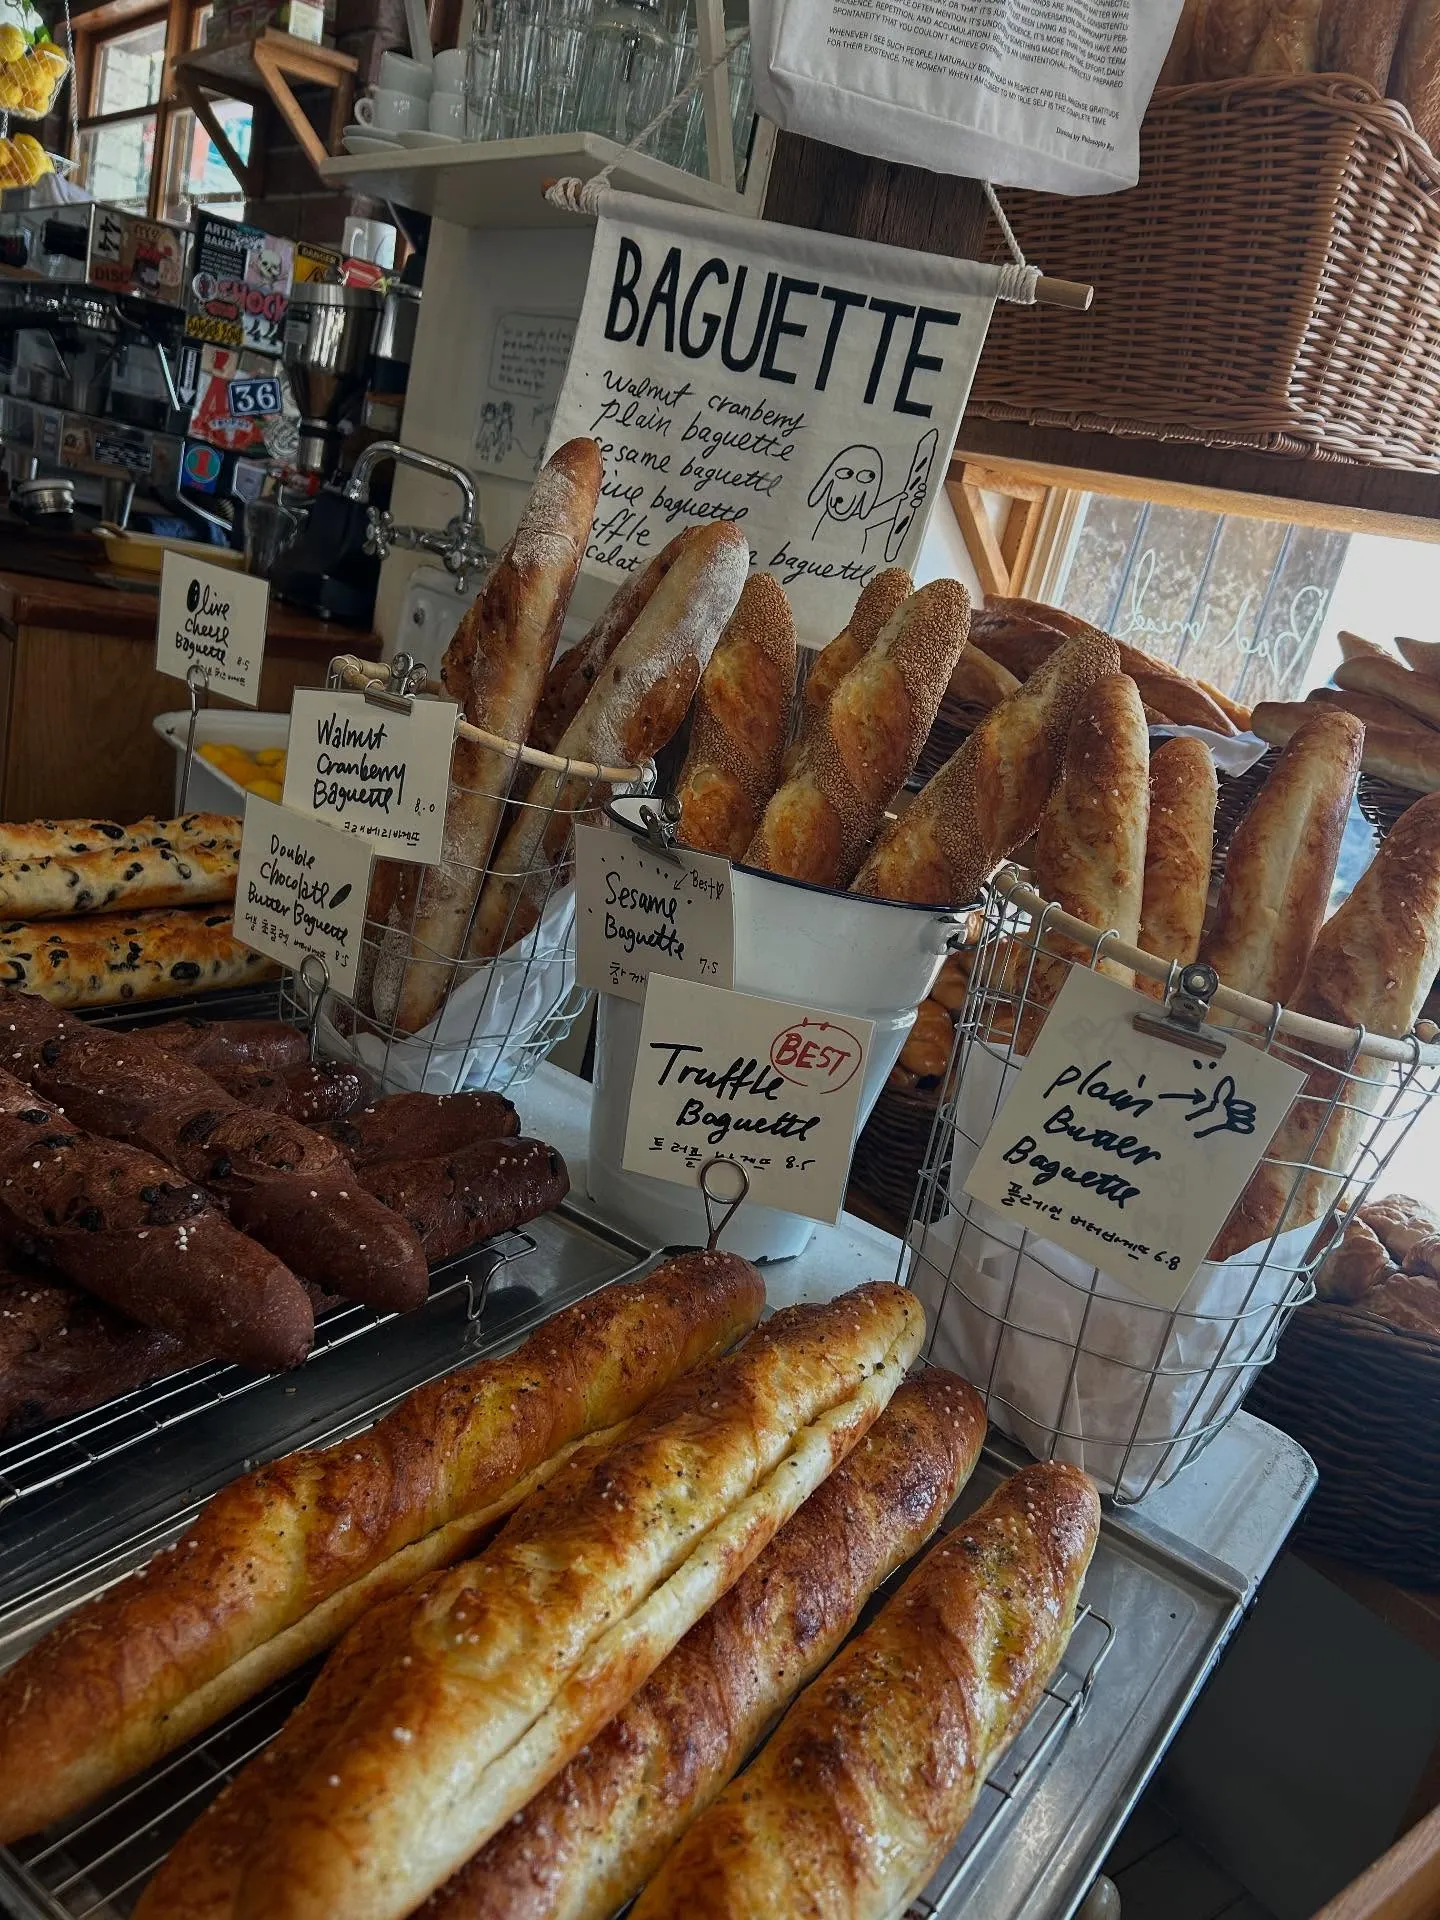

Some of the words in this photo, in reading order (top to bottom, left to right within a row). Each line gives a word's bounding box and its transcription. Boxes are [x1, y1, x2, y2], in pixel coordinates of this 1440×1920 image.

[833, 6, 881, 20] SPONTANEITY
[882, 15, 898, 26] THAT
[899, 22, 912, 32] YOU
[950, 36, 978, 49] ACHIEVE
[912, 2, 934, 14] OFTEN
[1106, 68, 1125, 76] DAILY
[949, 1, 958, 9] OR
[961, 4, 978, 14] THAT
[980, 6, 992, 14] IT'S
[993, 9, 1007, 19] JUST
[1046, 35, 1064, 45] MORE
[1108, 56, 1126, 65] TERM
[1037, 22, 1056, 32] LIVING
[1059, 26, 1067, 34] AS
[829, 26, 868, 39] WHENEVER
[873, 34, 885, 45] SEE
[887, 39, 904, 51] SUCH
[939, 54, 977, 69] NATURALLY
[1014, 81, 1039, 94] RESPECT
[1040, 88, 1053, 97] AND
[1055, 91, 1067, 101] FEEL
[916, 15, 931, 24] AND
[1092, 75, 1123, 88] PREPARED
[827, 37, 840, 47] FOR
[843, 41, 862, 50] THEIR
[902, 56, 914, 66] THE
[916, 60, 946, 74] MOMENT
[948, 67, 968, 80] WHEN
[974, 75, 984, 84] AM
[1033, 98, 1047, 107] SELF
[1055, 103, 1065, 112] THE
[1092, 116, 1106, 125] TIME
[302, 247, 337, 264] DANGER
[604, 236, 961, 419] BAGUETTE
[235, 383, 275, 412] 36
[708, 393, 808, 436] cranberry
[681, 412, 800, 461] baguette
[680, 456, 783, 497] baguette
[651, 485, 749, 523] baguette
[768, 541, 876, 588] baguette
[317, 712, 388, 750] Walnut
[313, 778, 394, 814] Baguette
[316, 753, 406, 805] Cranberry
[271, 834, 316, 869] Double
[248, 882, 291, 916] Butter
[294, 900, 349, 946] Baguette
[605, 871, 677, 924] Sesame
[605, 912, 684, 960] Baguette
[699, 958, 719, 974] 7.5
[650, 1042, 784, 1100] Truffle
[775, 1032, 851, 1077] BEST
[676, 1098, 820, 1144] Baguette
[1043, 1105, 1161, 1165] Butter
[785, 1156, 815, 1170] 8.5
[1002, 1135, 1142, 1209] Baguette
[1154, 1250, 1181, 1271] 6.8
